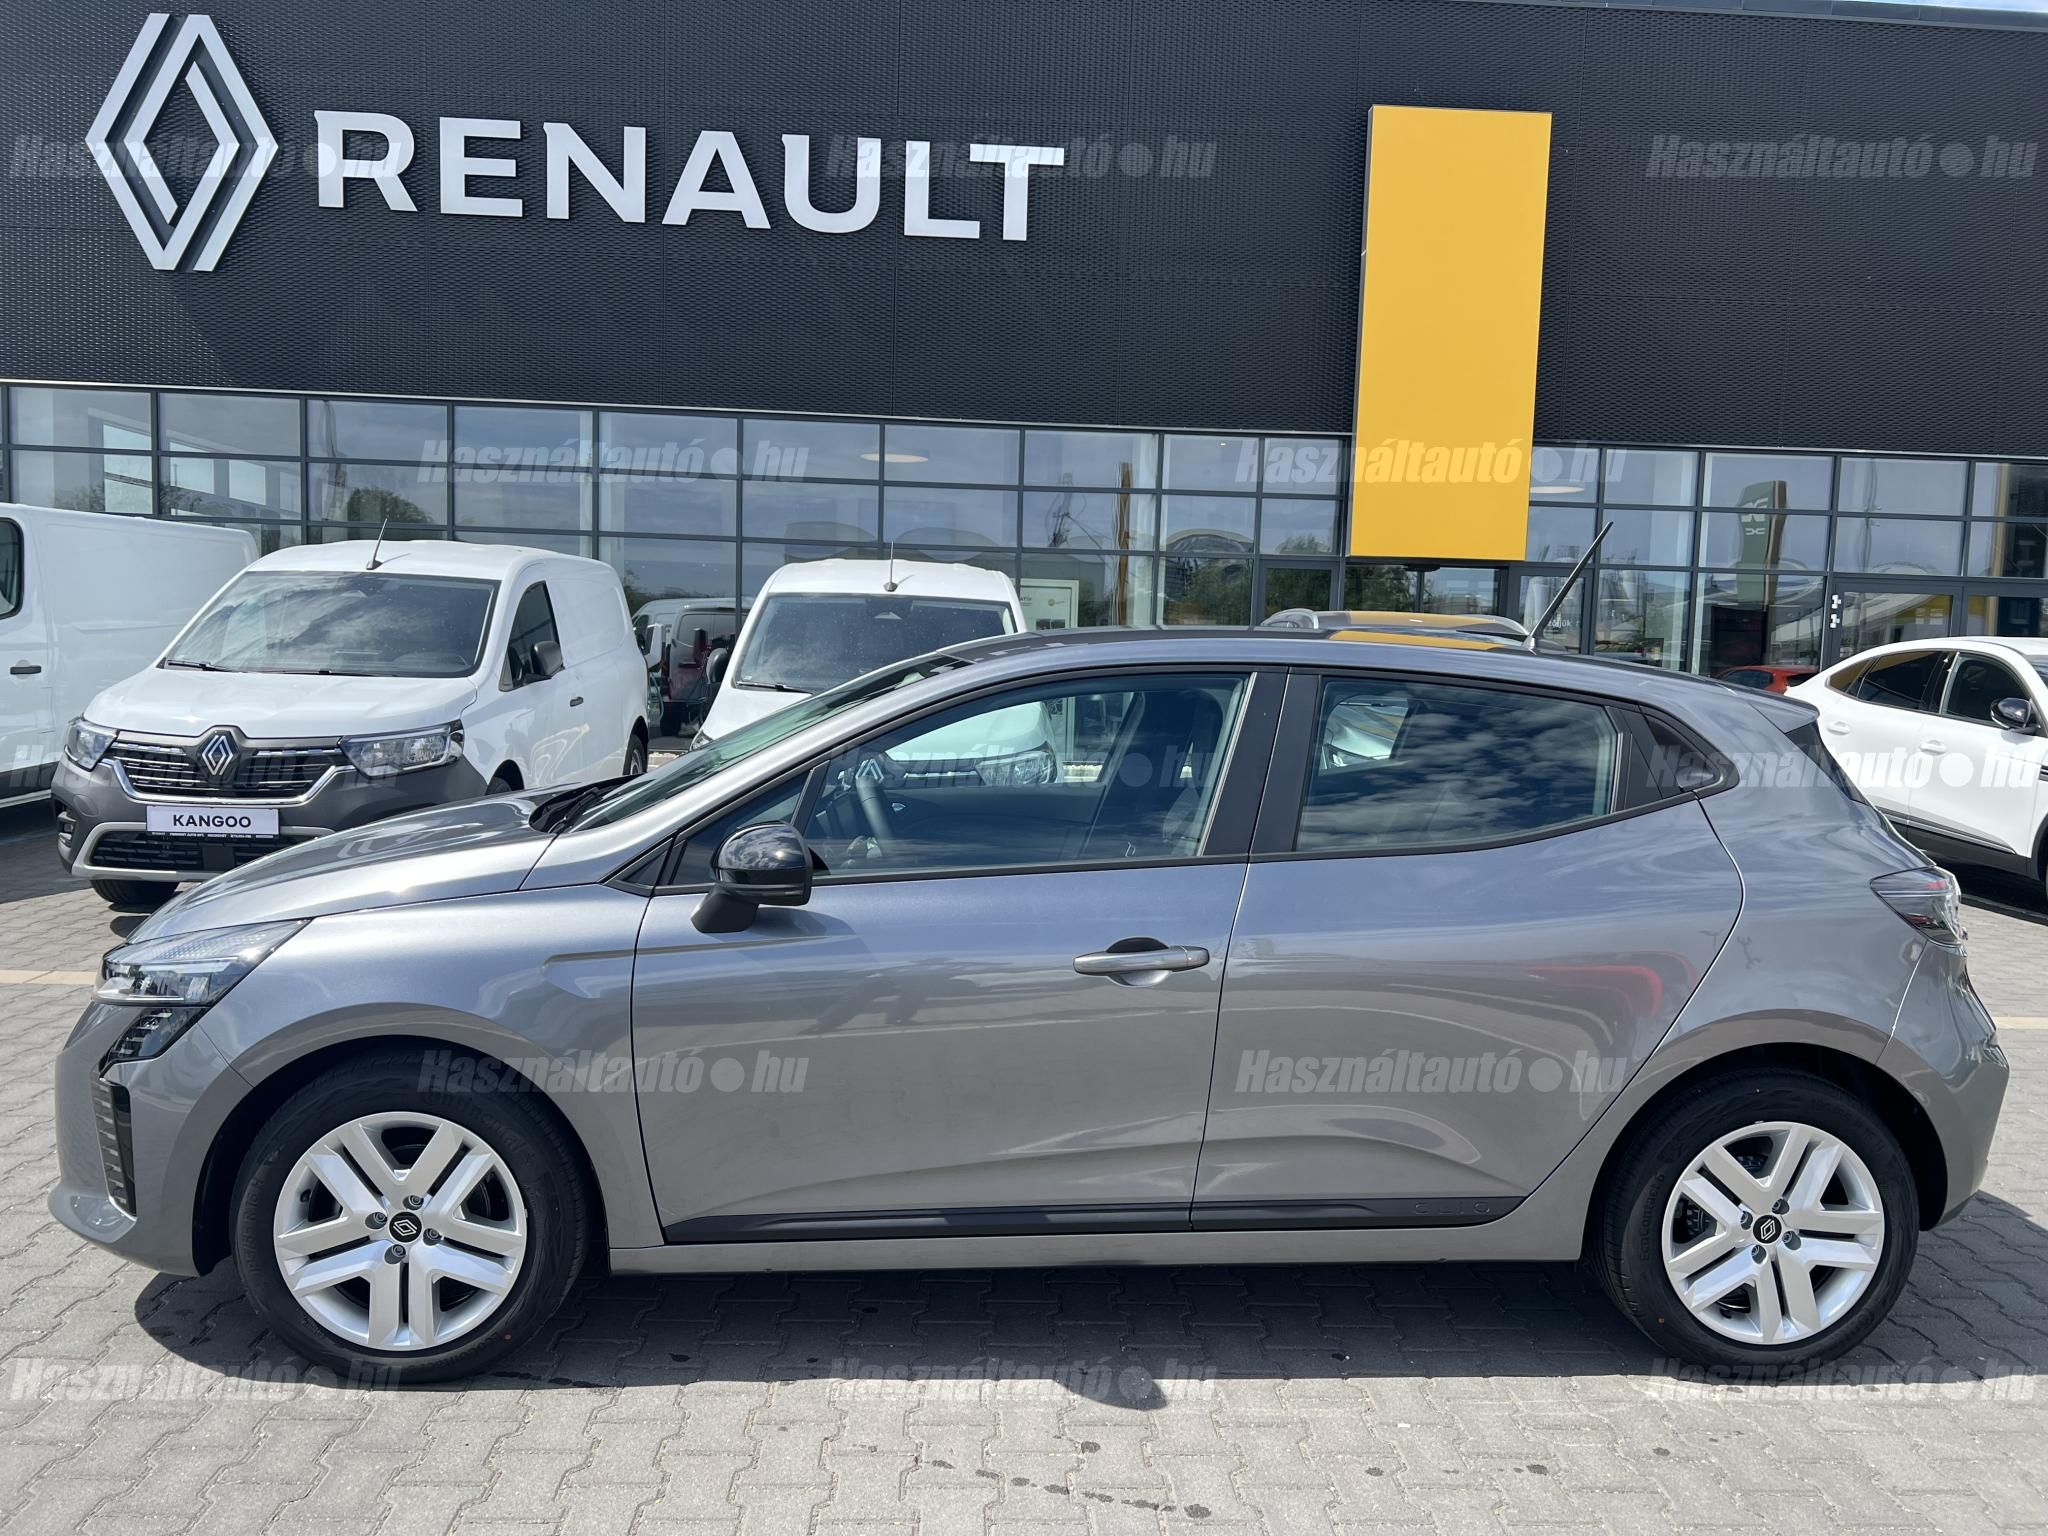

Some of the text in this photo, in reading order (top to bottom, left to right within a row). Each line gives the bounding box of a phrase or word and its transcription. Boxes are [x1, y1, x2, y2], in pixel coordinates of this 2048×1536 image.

[314, 110, 1065, 241] RENAULT
[173, 814, 251, 828] KANGOO
[1415, 1201, 1491, 1216] CLIO
